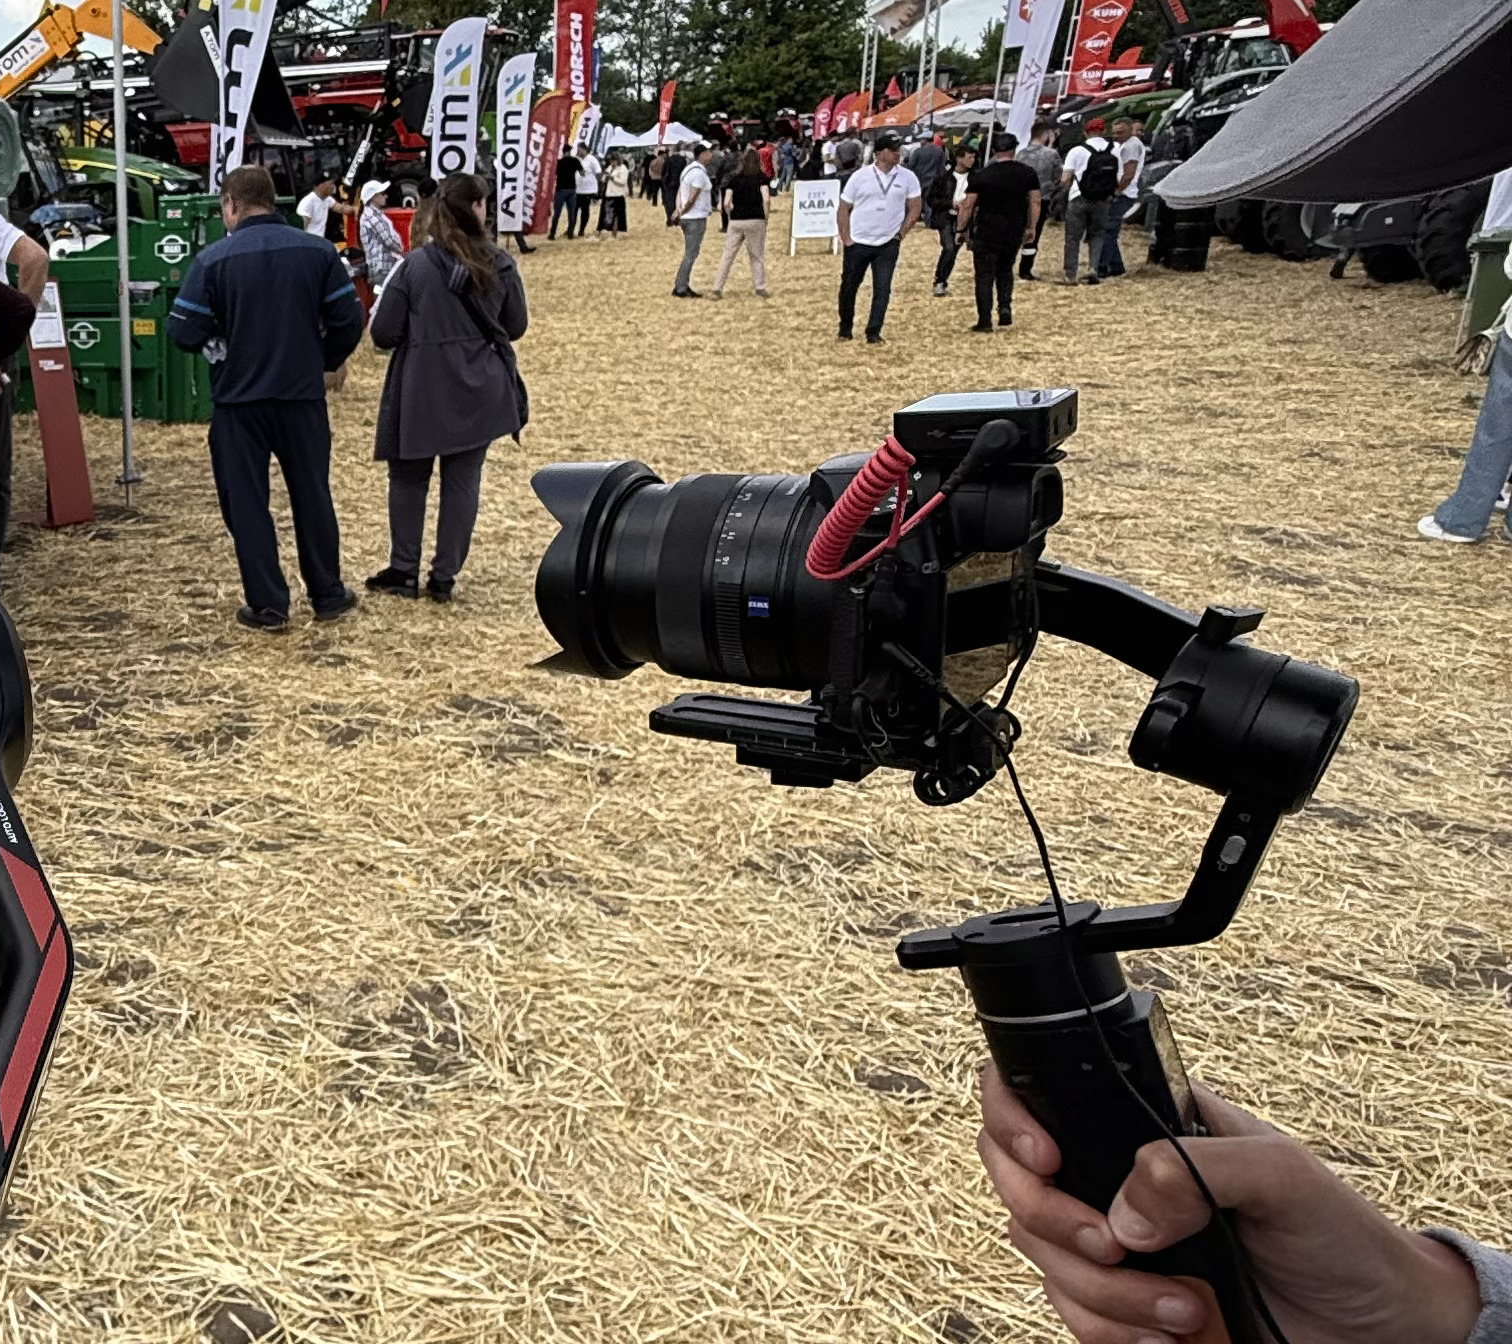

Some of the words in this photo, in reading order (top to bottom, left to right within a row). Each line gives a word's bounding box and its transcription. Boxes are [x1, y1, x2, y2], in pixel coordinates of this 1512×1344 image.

[569, 12, 586, 101] HORSCH
[500, 110, 522, 218] A.TOM
[522, 121, 548, 227] HORSCH
[2, 821, 19, 844] AUTO
